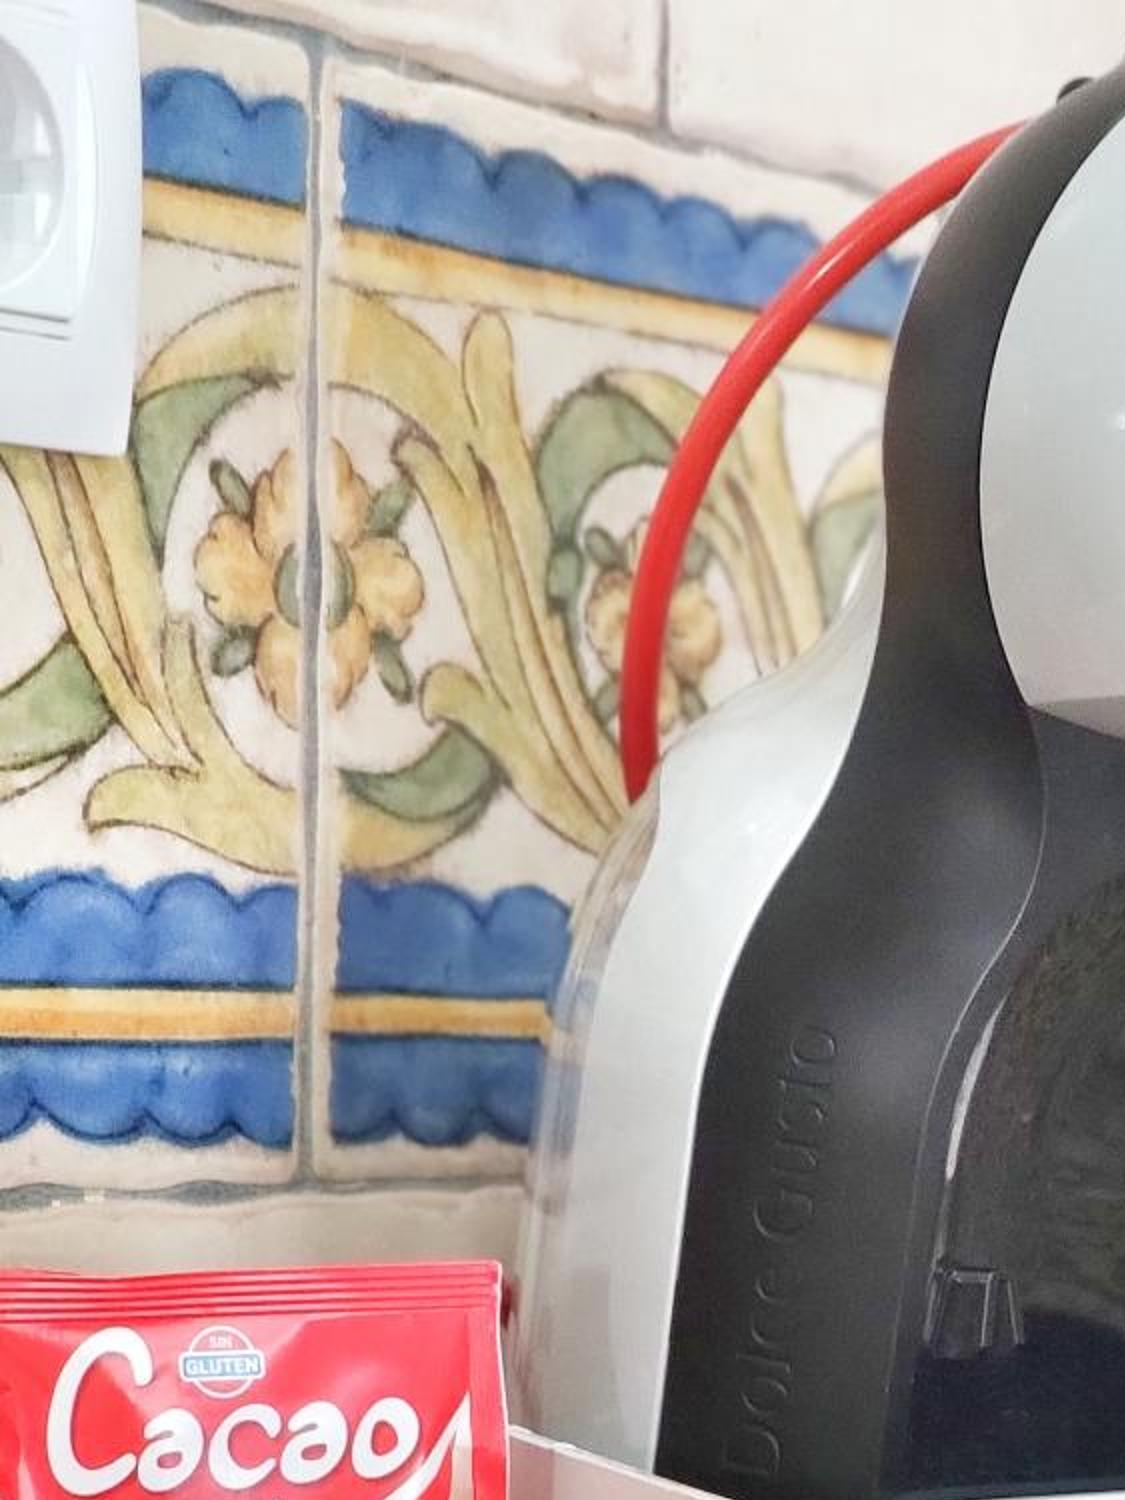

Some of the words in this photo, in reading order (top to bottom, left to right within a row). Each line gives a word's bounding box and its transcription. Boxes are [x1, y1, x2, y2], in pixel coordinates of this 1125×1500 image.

[752, 1027, 838, 1239] Gusto
[46, 1326, 420, 1497] Cacao
[185, 1356, 260, 1376] GLUTEN
